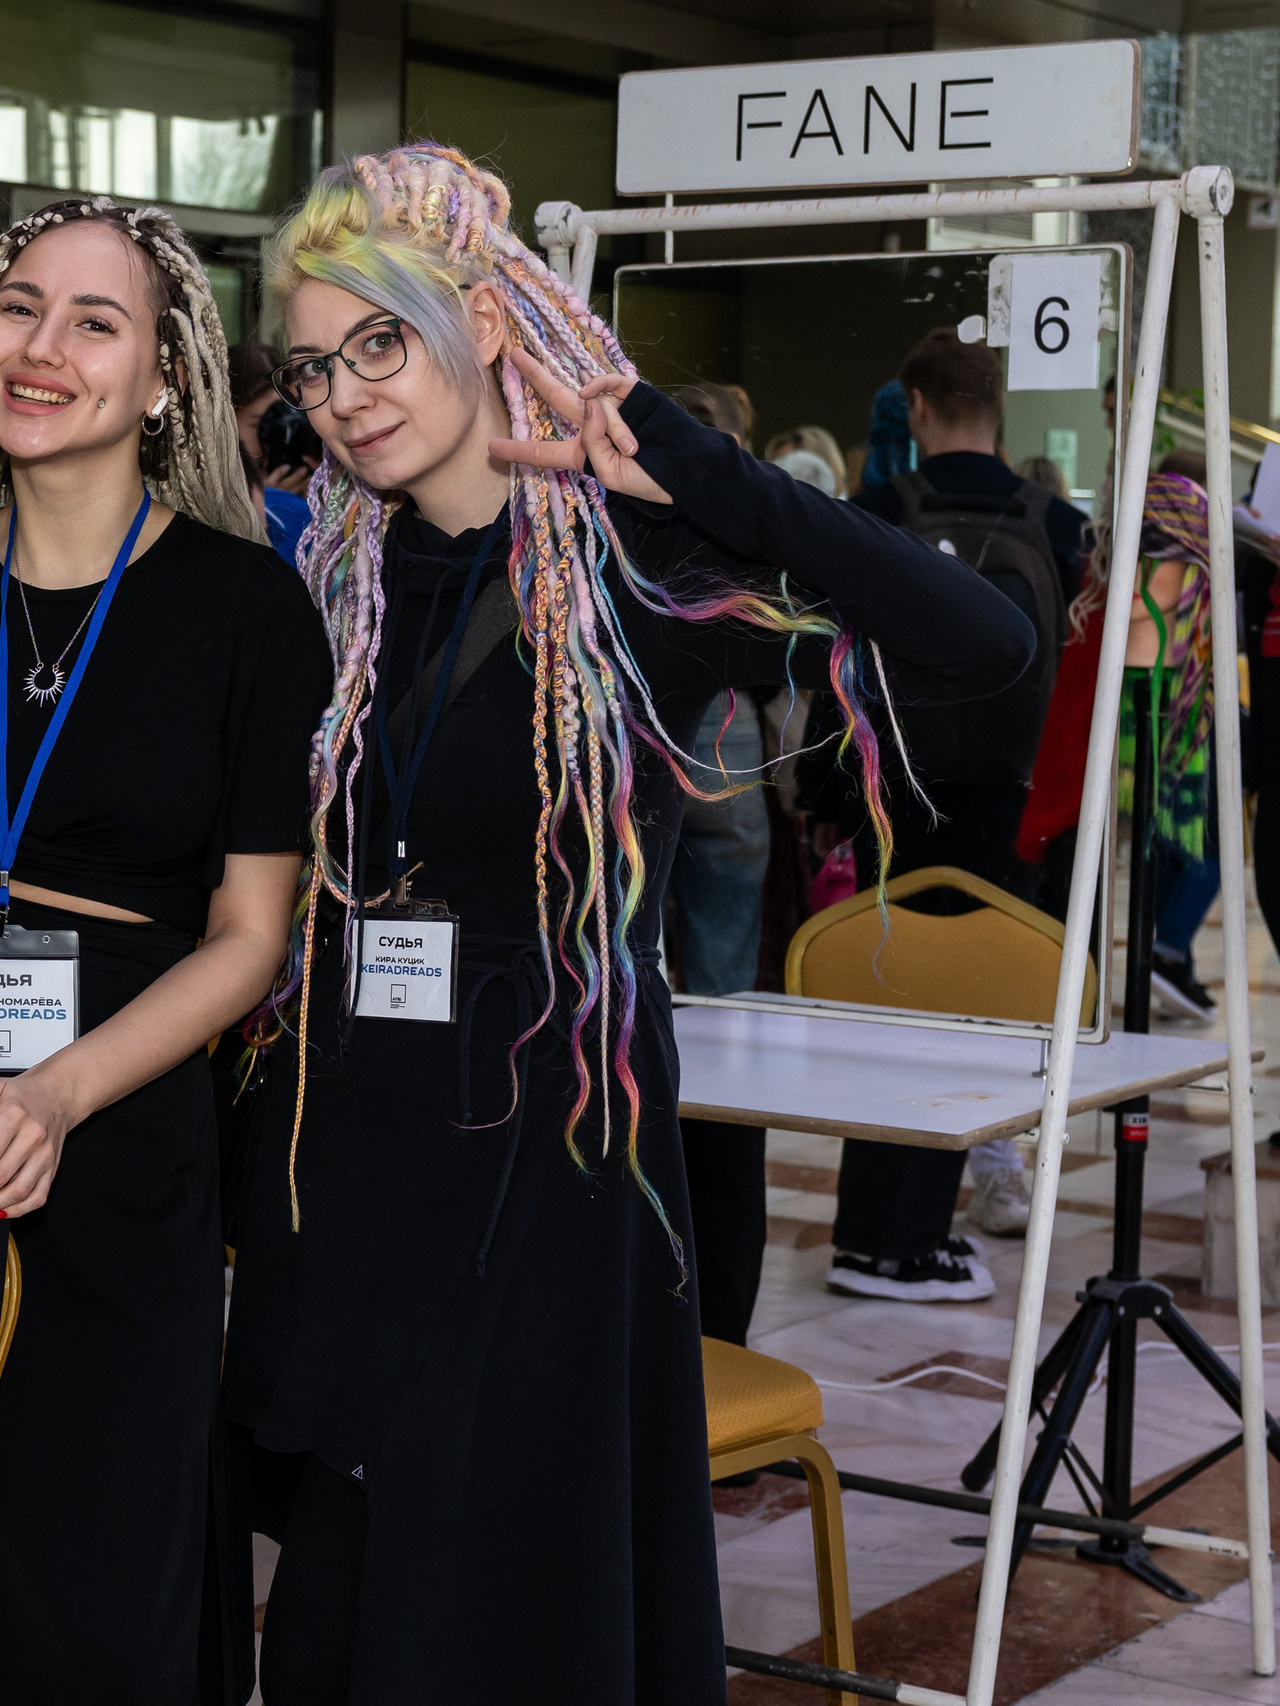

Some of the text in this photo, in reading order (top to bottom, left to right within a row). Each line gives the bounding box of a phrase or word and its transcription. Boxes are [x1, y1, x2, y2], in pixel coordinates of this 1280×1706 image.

[735, 76, 994, 162] FANE
[1032, 295, 1071, 355] 6
[379, 936, 423, 949] СУДЬЯ
[375, 956, 425, 965] КИРА КУЦИК
[361, 964, 442, 977] KEIRADREADS
